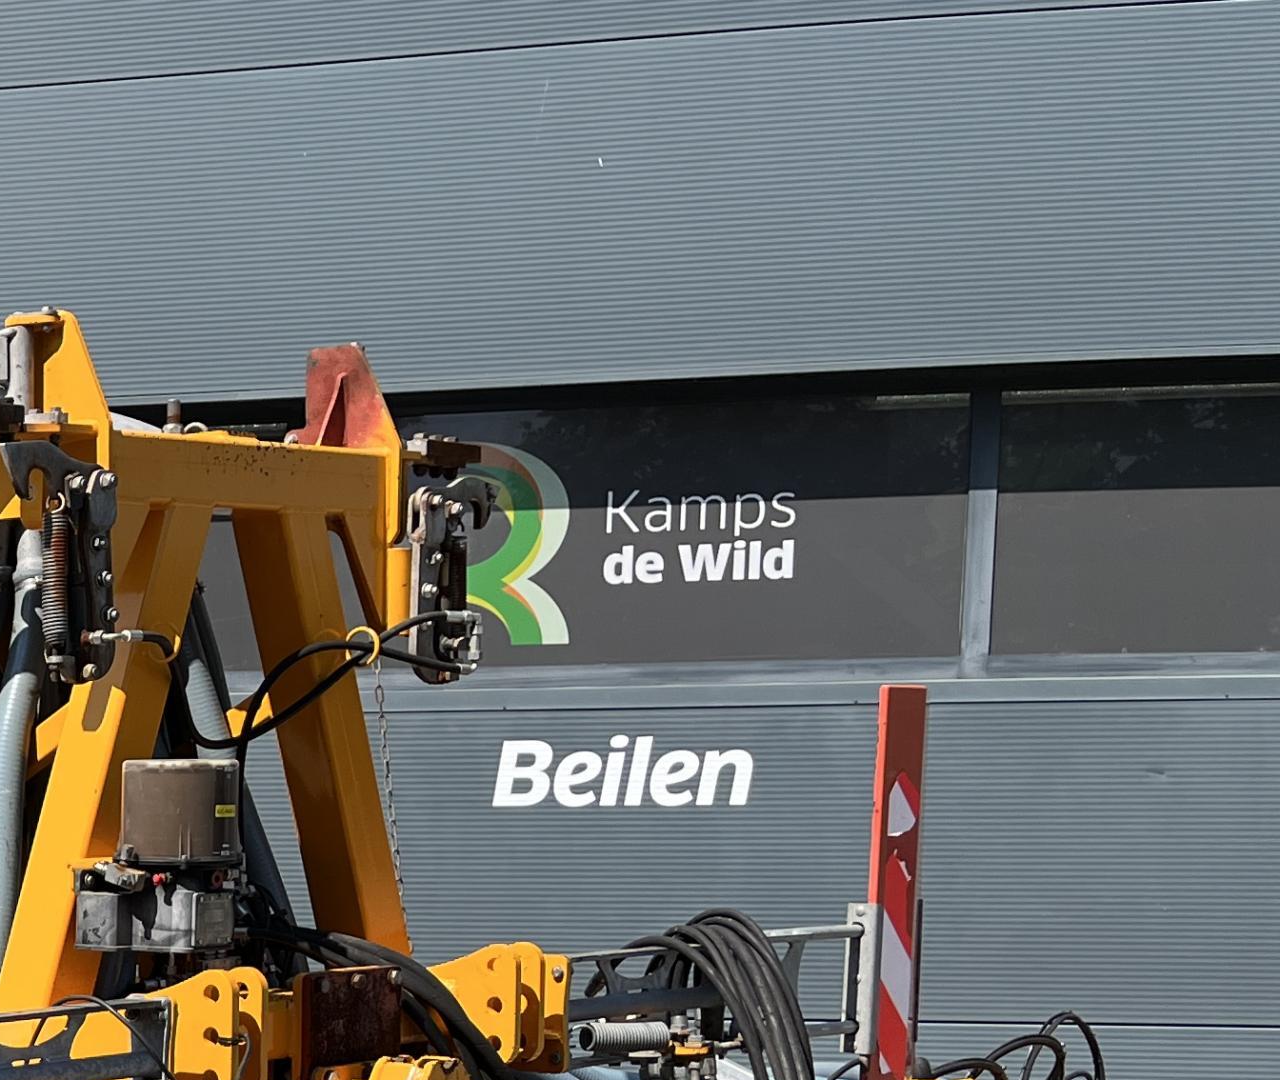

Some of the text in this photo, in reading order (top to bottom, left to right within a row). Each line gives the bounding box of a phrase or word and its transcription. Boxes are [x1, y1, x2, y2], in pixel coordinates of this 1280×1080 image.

[606, 489, 797, 537] Kamps
[602, 540, 795, 585] de Wild
[491, 734, 755, 807] Beilen
